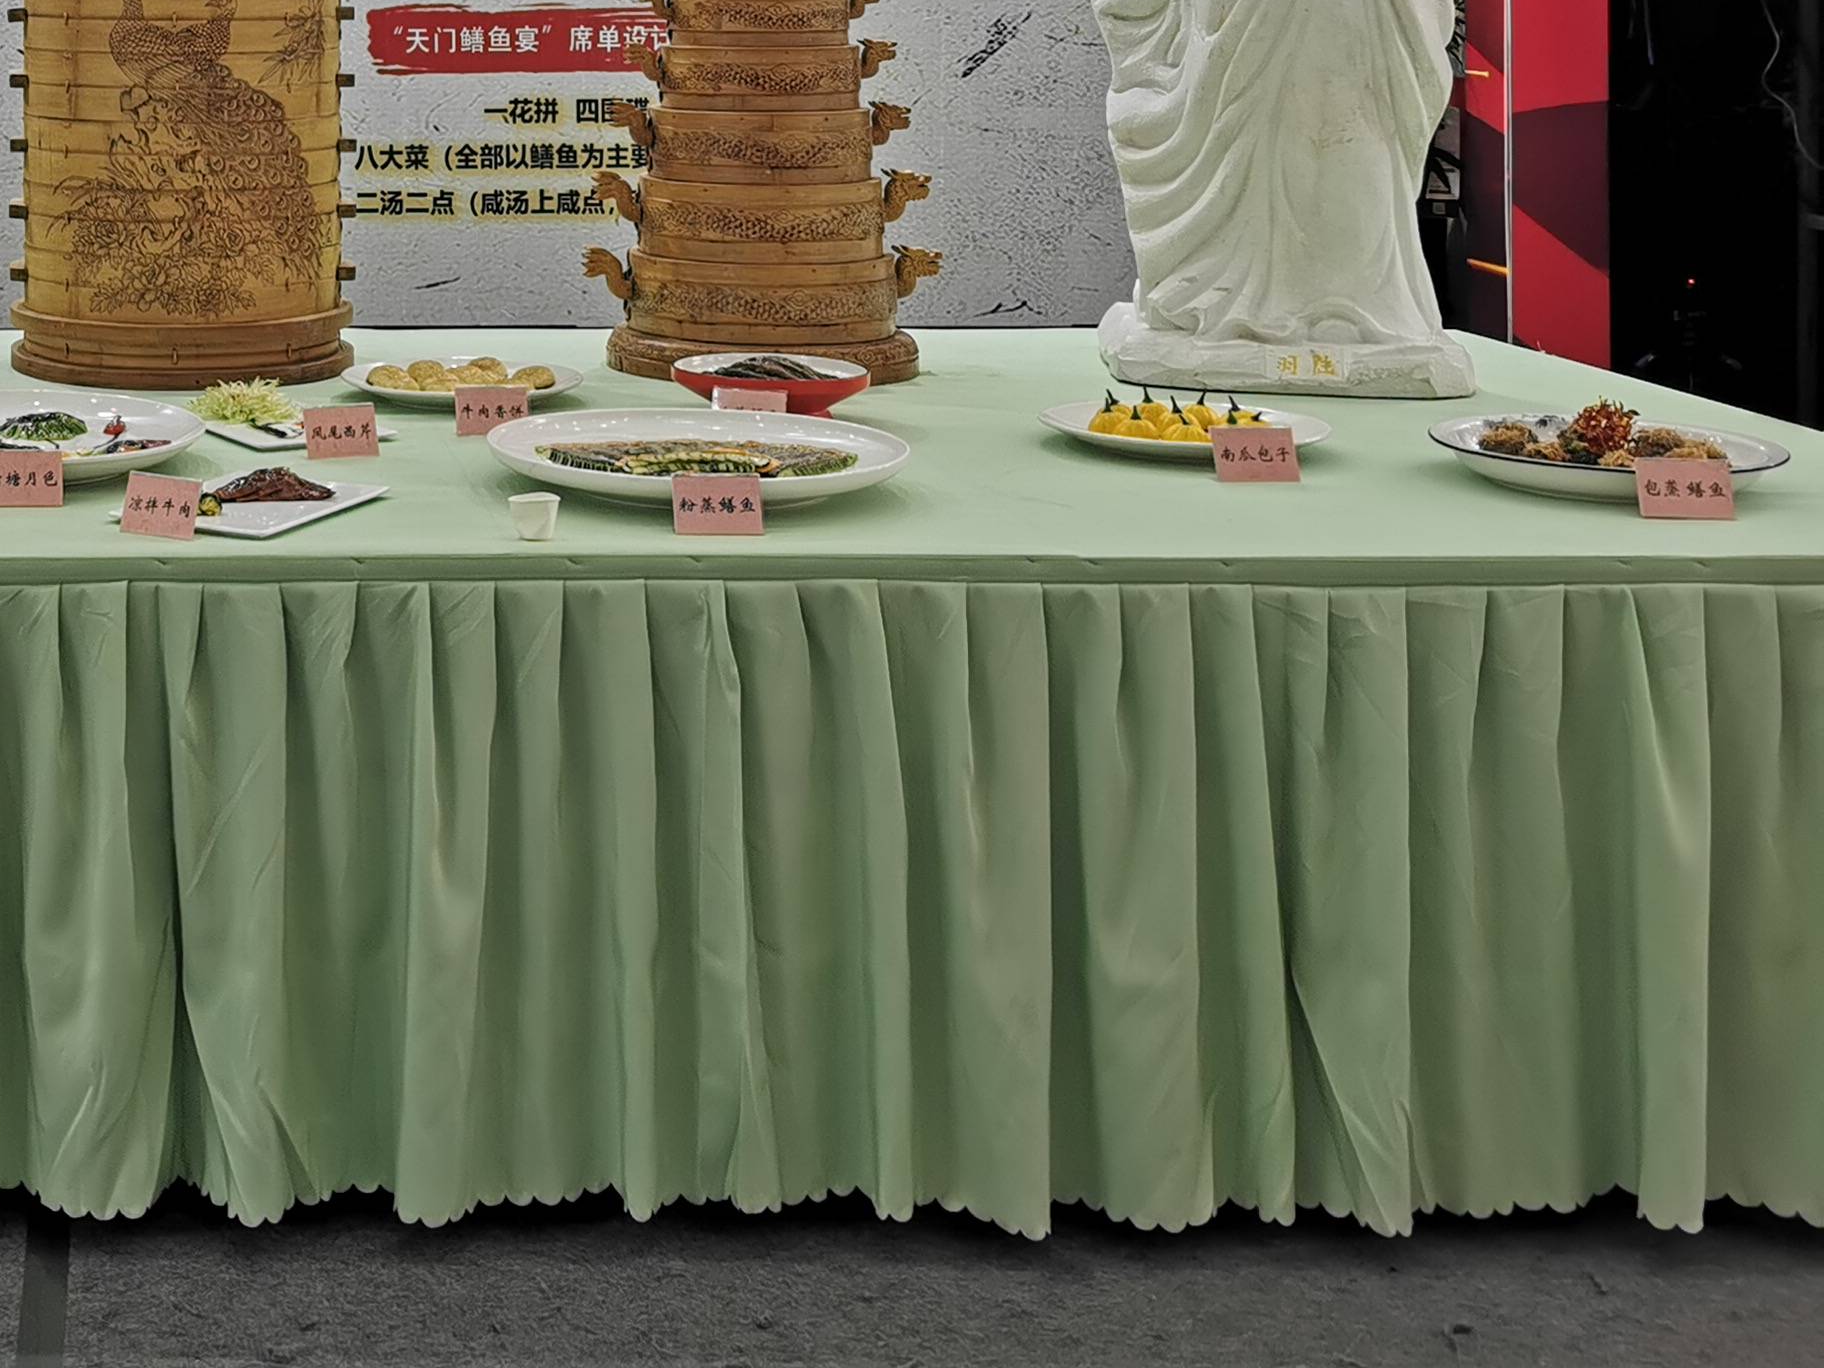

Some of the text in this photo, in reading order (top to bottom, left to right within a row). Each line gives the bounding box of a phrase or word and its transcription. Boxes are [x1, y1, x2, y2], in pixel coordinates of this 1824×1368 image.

[1221, 445, 1290, 463] 南瓜包子
[679, 496, 756, 514] 粉蒸鳝鱼
